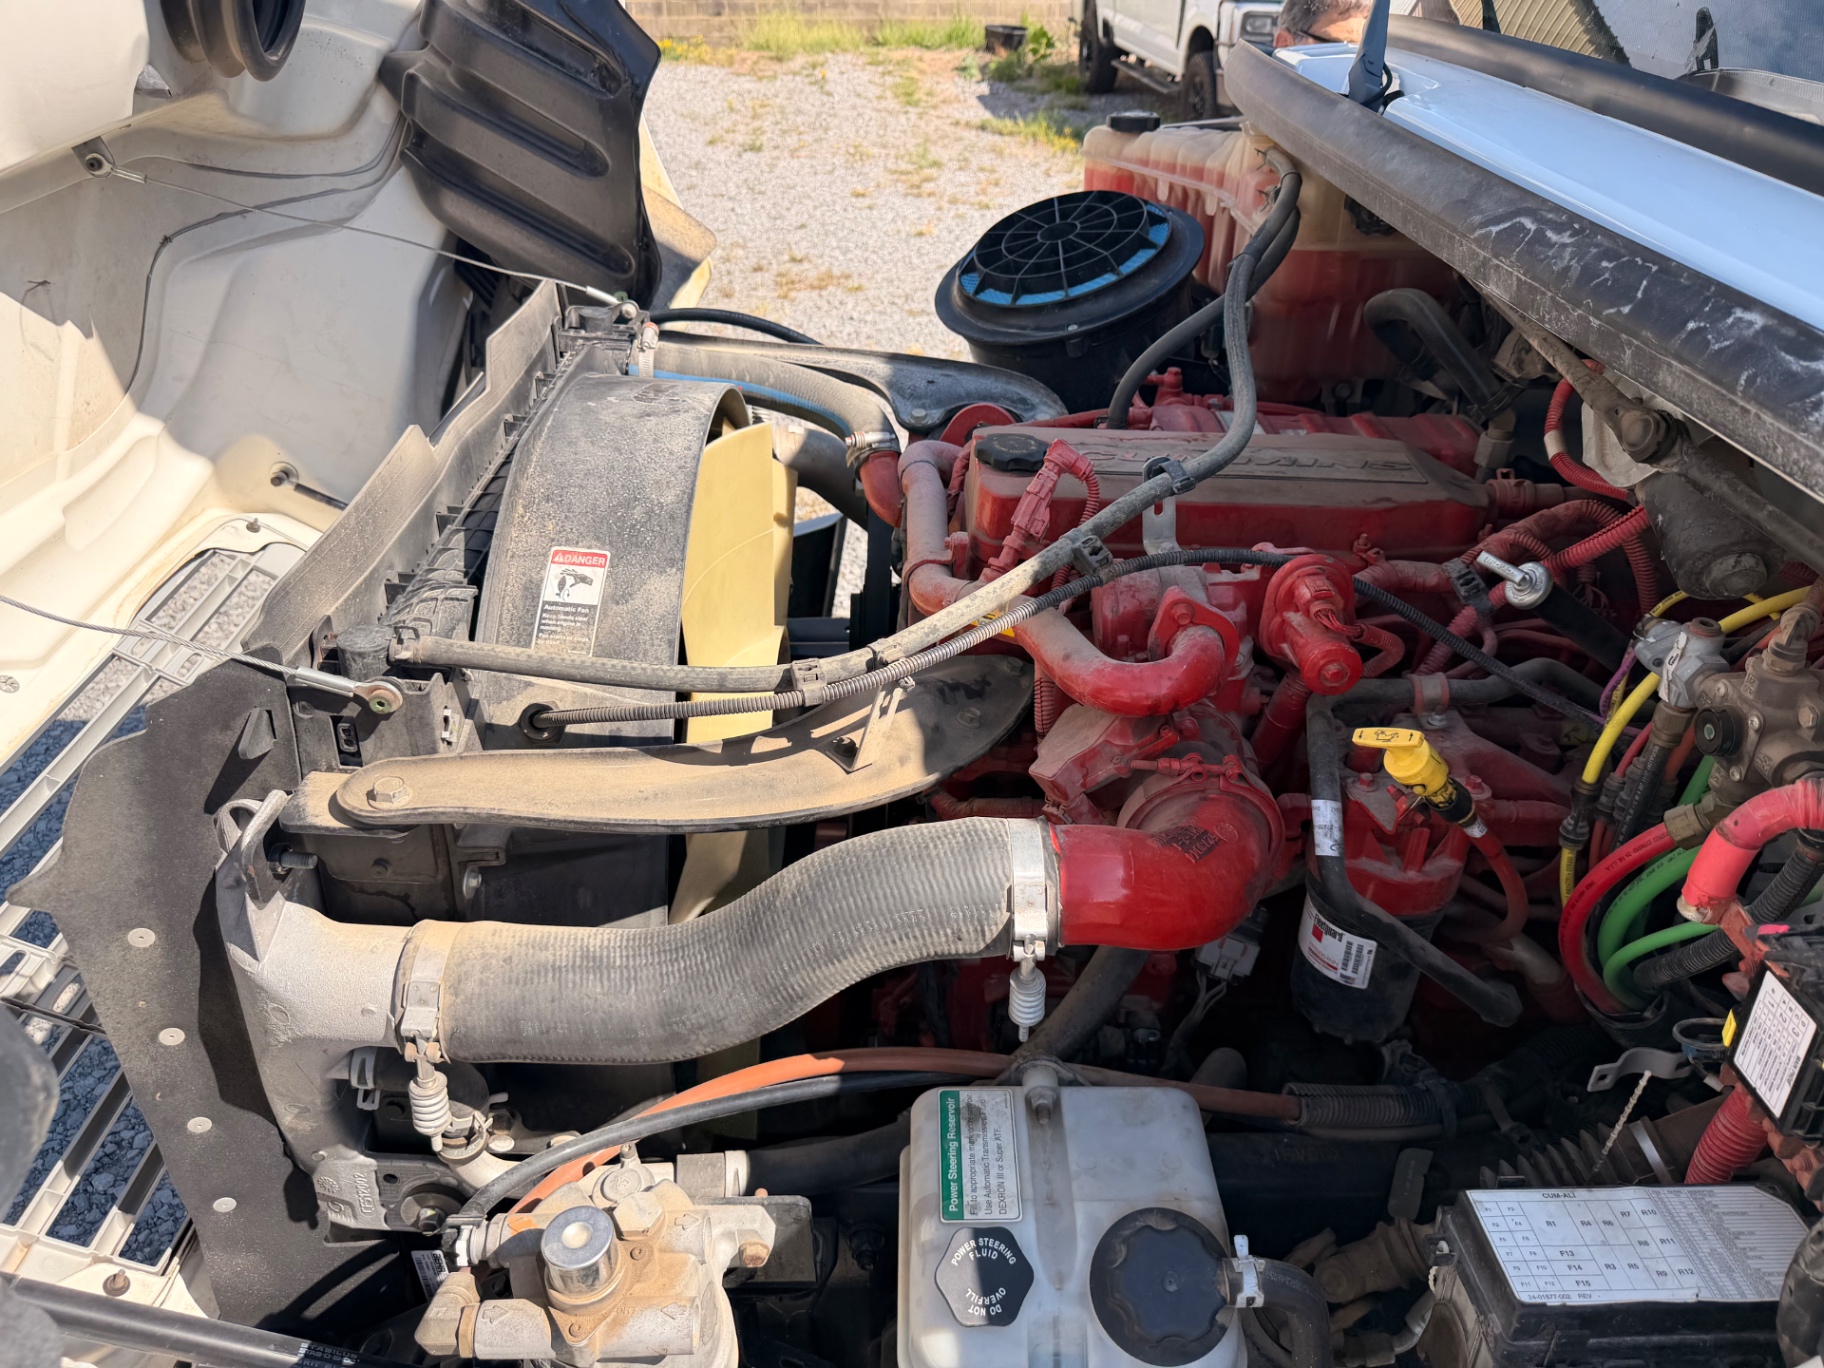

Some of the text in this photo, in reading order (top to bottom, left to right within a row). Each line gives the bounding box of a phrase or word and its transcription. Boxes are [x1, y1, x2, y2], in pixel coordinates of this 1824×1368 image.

[565, 554, 605, 566] DANGER
[544, 604, 590, 614] Automatic Fan
[1768, 1000, 1774, 1009] 1
[1779, 1012, 1787, 1023] 2
[1792, 1027, 1799, 1037] 3
[946, 1098, 959, 1212] Power Steering Reservoir
[996, 1143, 1005, 1163] Super
[969, 1152, 979, 1193] appropriate
[983, 1161, 992, 1199] Automatic
[971, 1194, 978, 1203] to
[998, 1182, 1007, 1215] DEXRON
[984, 1200, 993, 1215] Use
[951, 1237, 1017, 1266] POWER STEERING
[968, 1247, 998, 1261] FLUID
[1575, 1279, 1591, 1287] F15
[965, 1287, 1006, 1305] OVERFILL
[967, 1304, 1002, 1317] DO NOT
[301, 1342, 358, 1359] STABILUS
